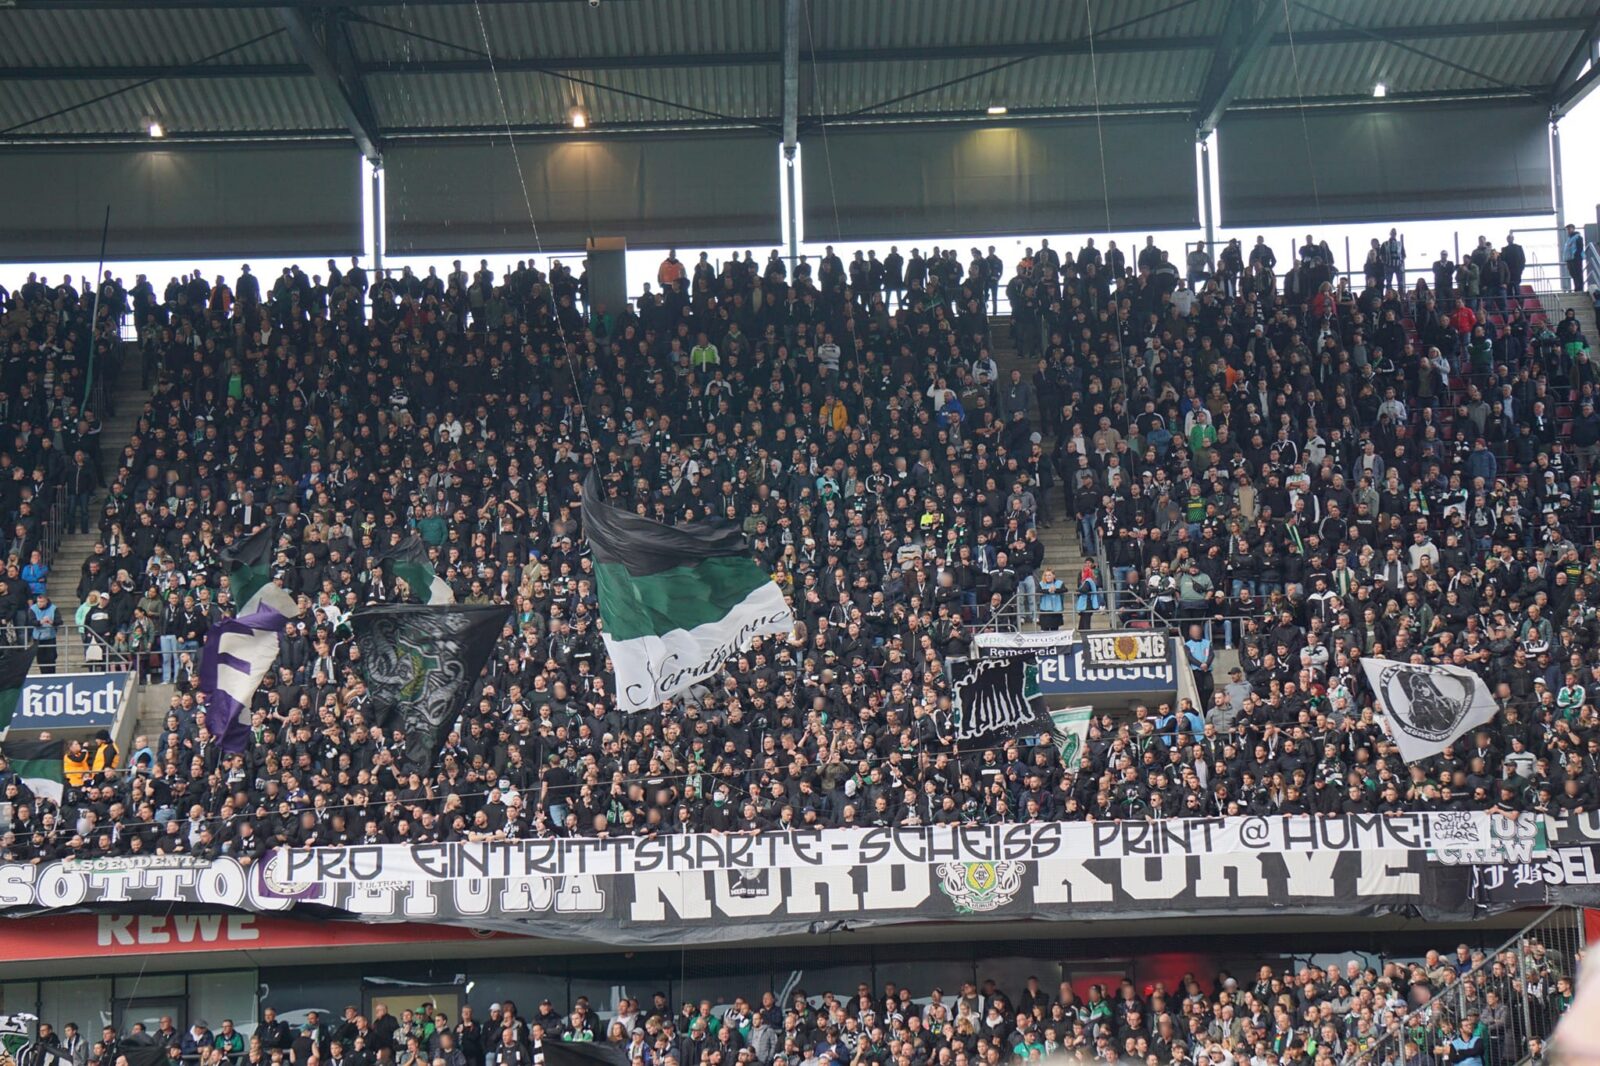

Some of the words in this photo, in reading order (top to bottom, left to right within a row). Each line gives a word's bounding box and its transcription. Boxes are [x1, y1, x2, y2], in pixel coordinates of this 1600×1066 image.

[286, 846, 383, 880] PRO
[1093, 816, 1226, 857] PRINT
[1240, 815, 1270, 848] @
[1284, 812, 1431, 851] HOME!
[97, 914, 260, 946] REWE
